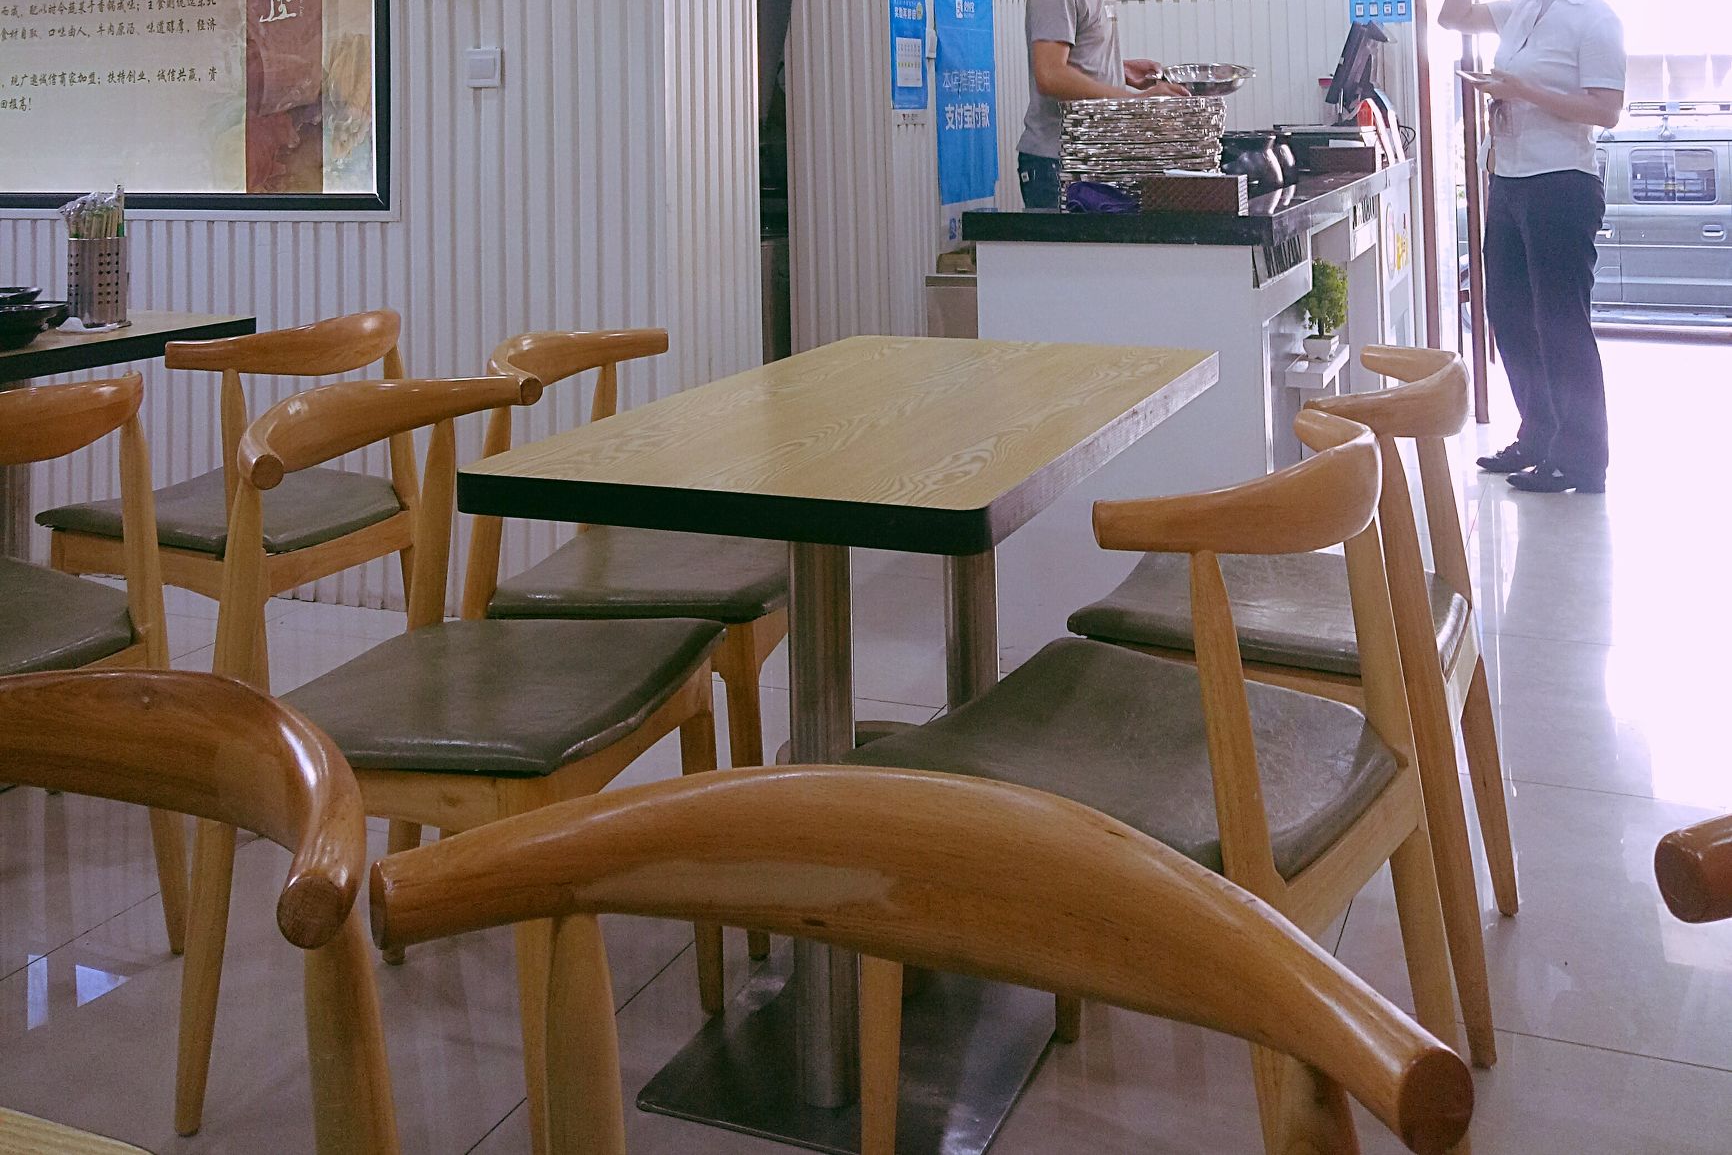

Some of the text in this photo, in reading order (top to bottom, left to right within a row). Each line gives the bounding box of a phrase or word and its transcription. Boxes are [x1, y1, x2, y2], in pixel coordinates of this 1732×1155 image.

[942, 69, 991, 93] 本店推荐使用
[944, 102, 990, 131] 支付宝付款
